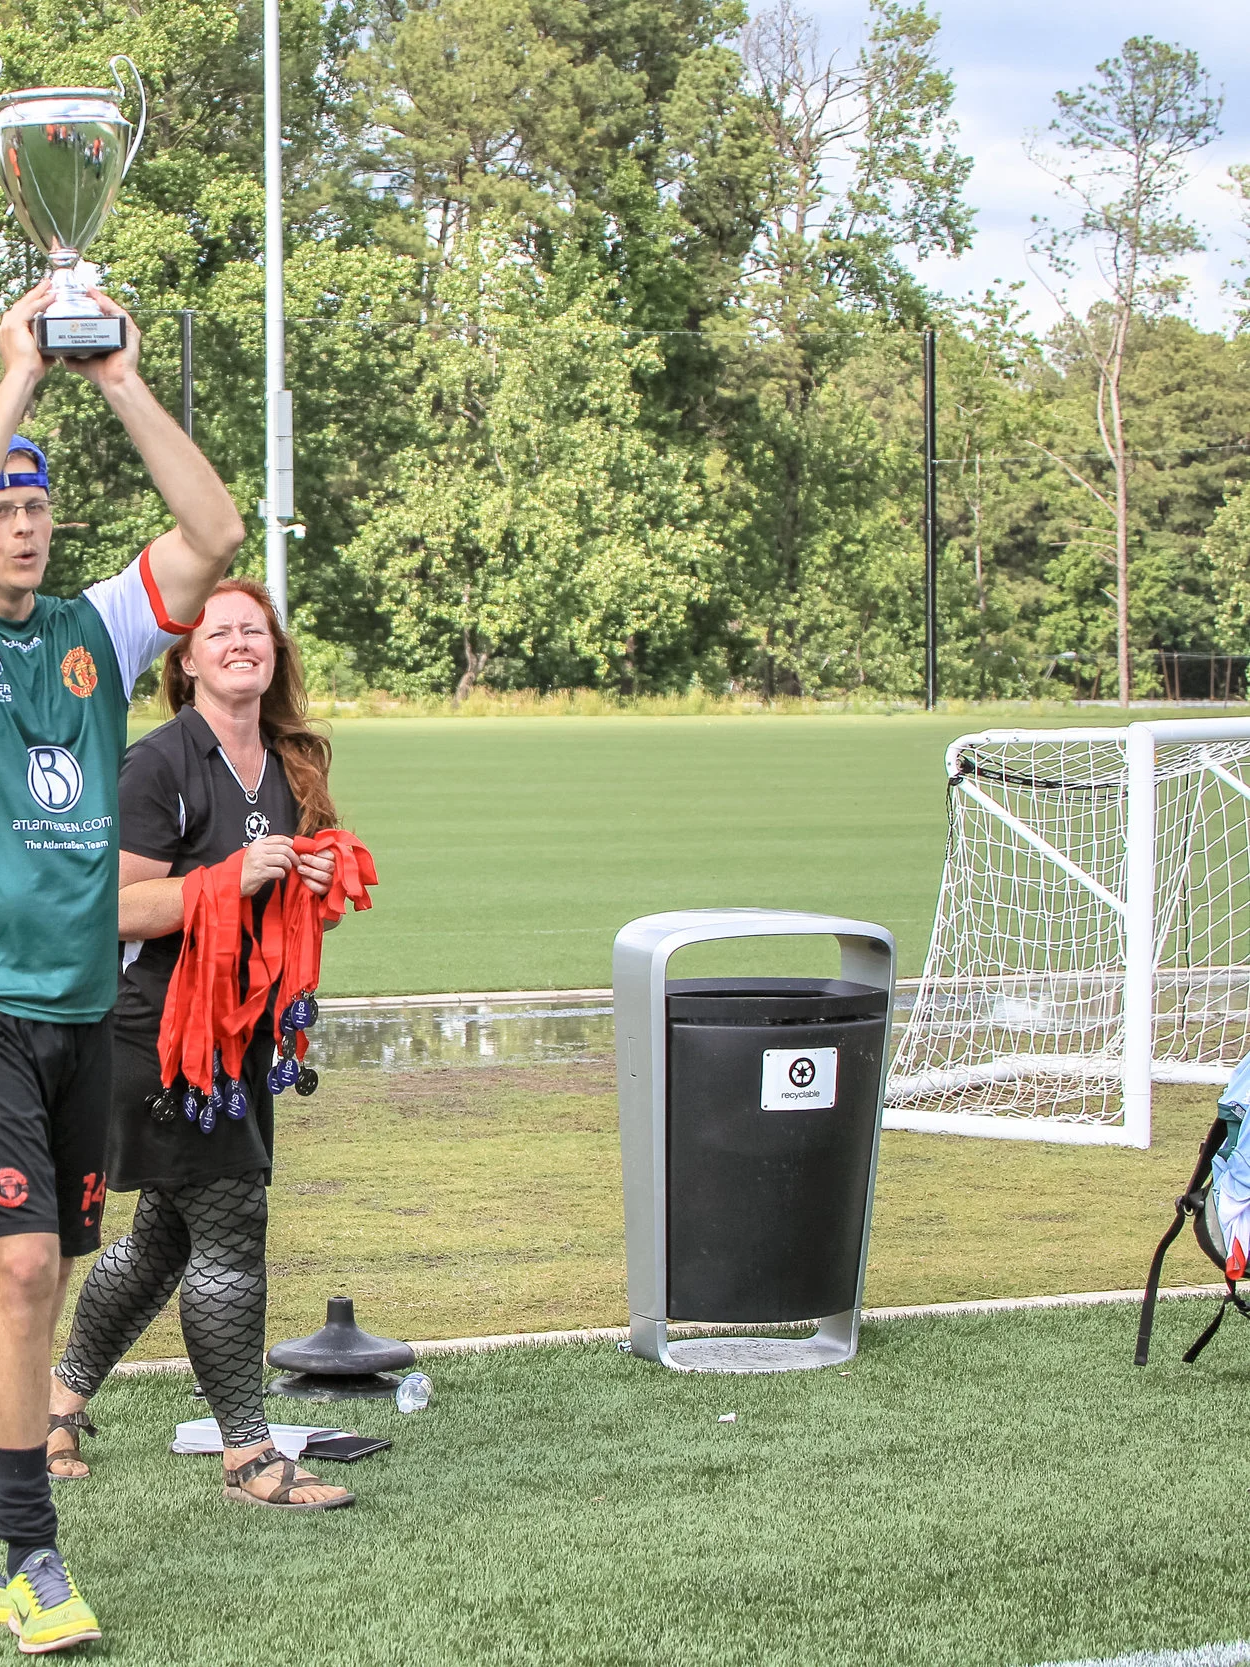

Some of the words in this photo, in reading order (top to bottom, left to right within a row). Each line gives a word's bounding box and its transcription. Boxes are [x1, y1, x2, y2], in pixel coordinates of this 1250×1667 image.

[24, 840, 42, 850] The
[43, 840, 85, 850] AtlantaBen
[85, 839, 109, 850] Team
[781, 1090, 821, 1100] recyclable
